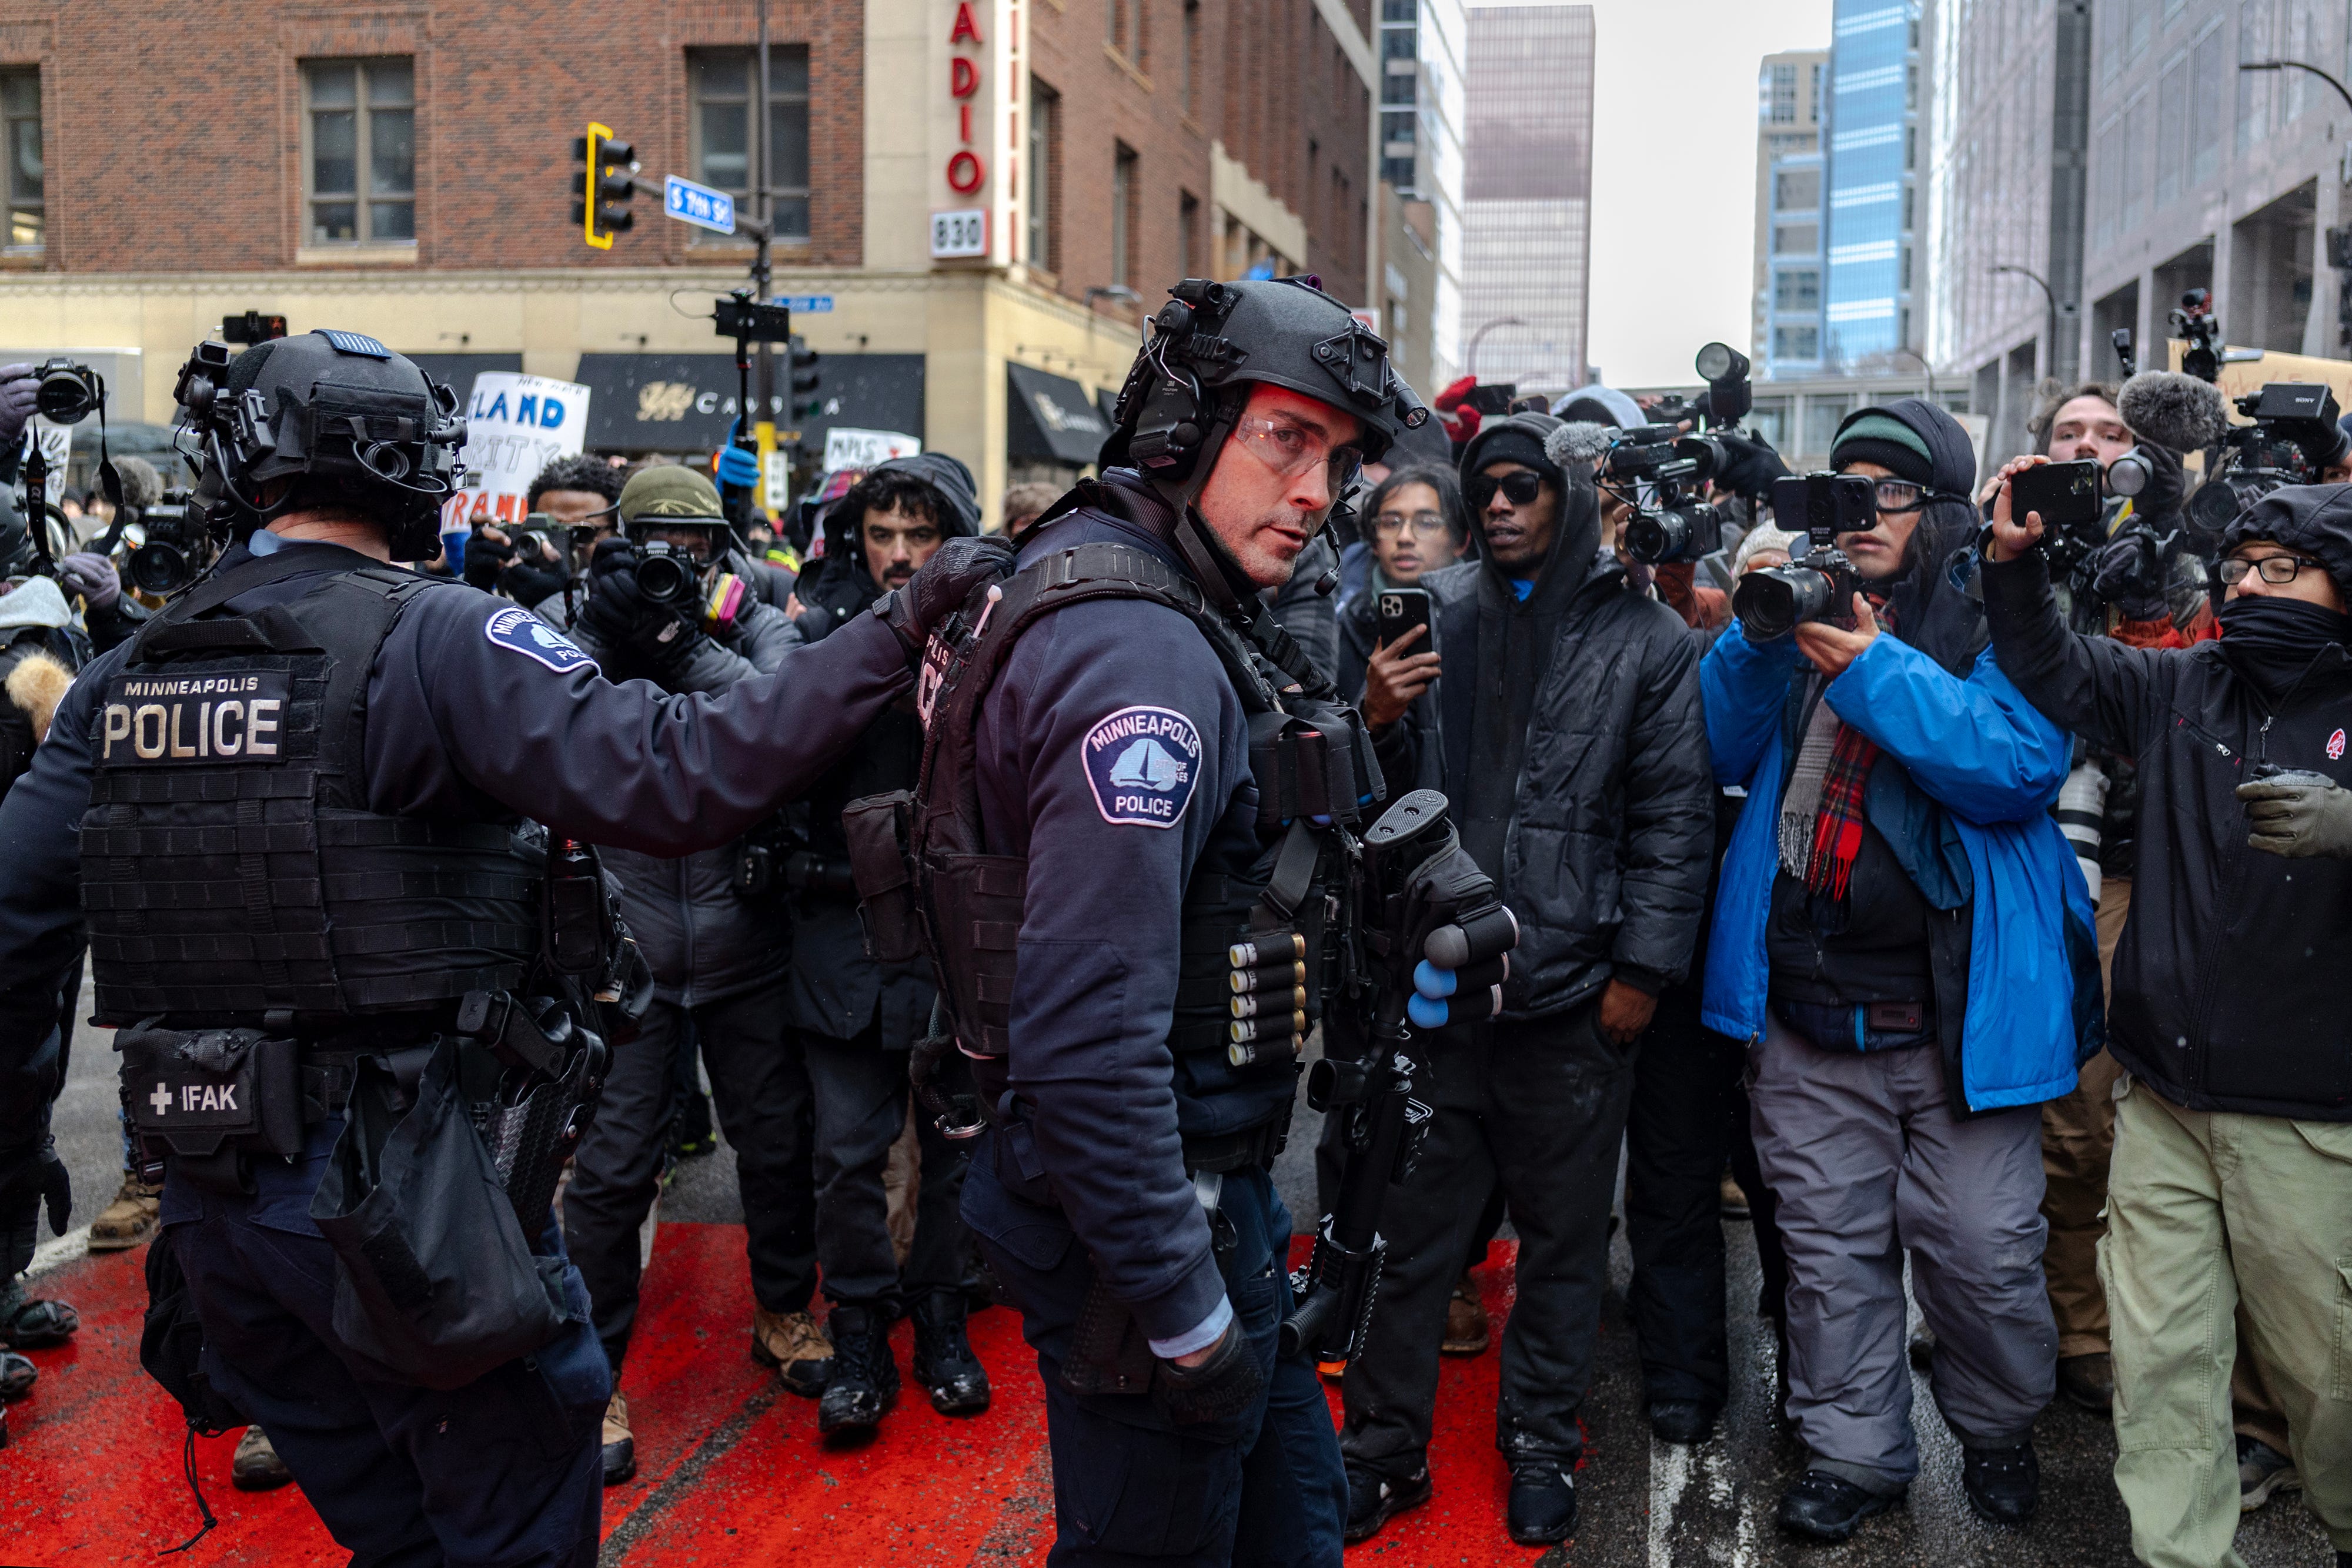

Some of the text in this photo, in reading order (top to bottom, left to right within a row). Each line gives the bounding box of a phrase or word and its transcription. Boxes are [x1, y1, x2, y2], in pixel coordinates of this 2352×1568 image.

[671, 185, 683, 210] S
[934, 218, 983, 249] 830
[466, 434, 561, 474] RITY
[124, 677, 259, 696] MINNEAPOLIS
[103, 699, 281, 759] POLICE
[1090, 715, 1198, 758] MINNEAPOLIS
[1115, 795, 1173, 817] POLICE
[182, 1084, 238, 1111] IFAK
